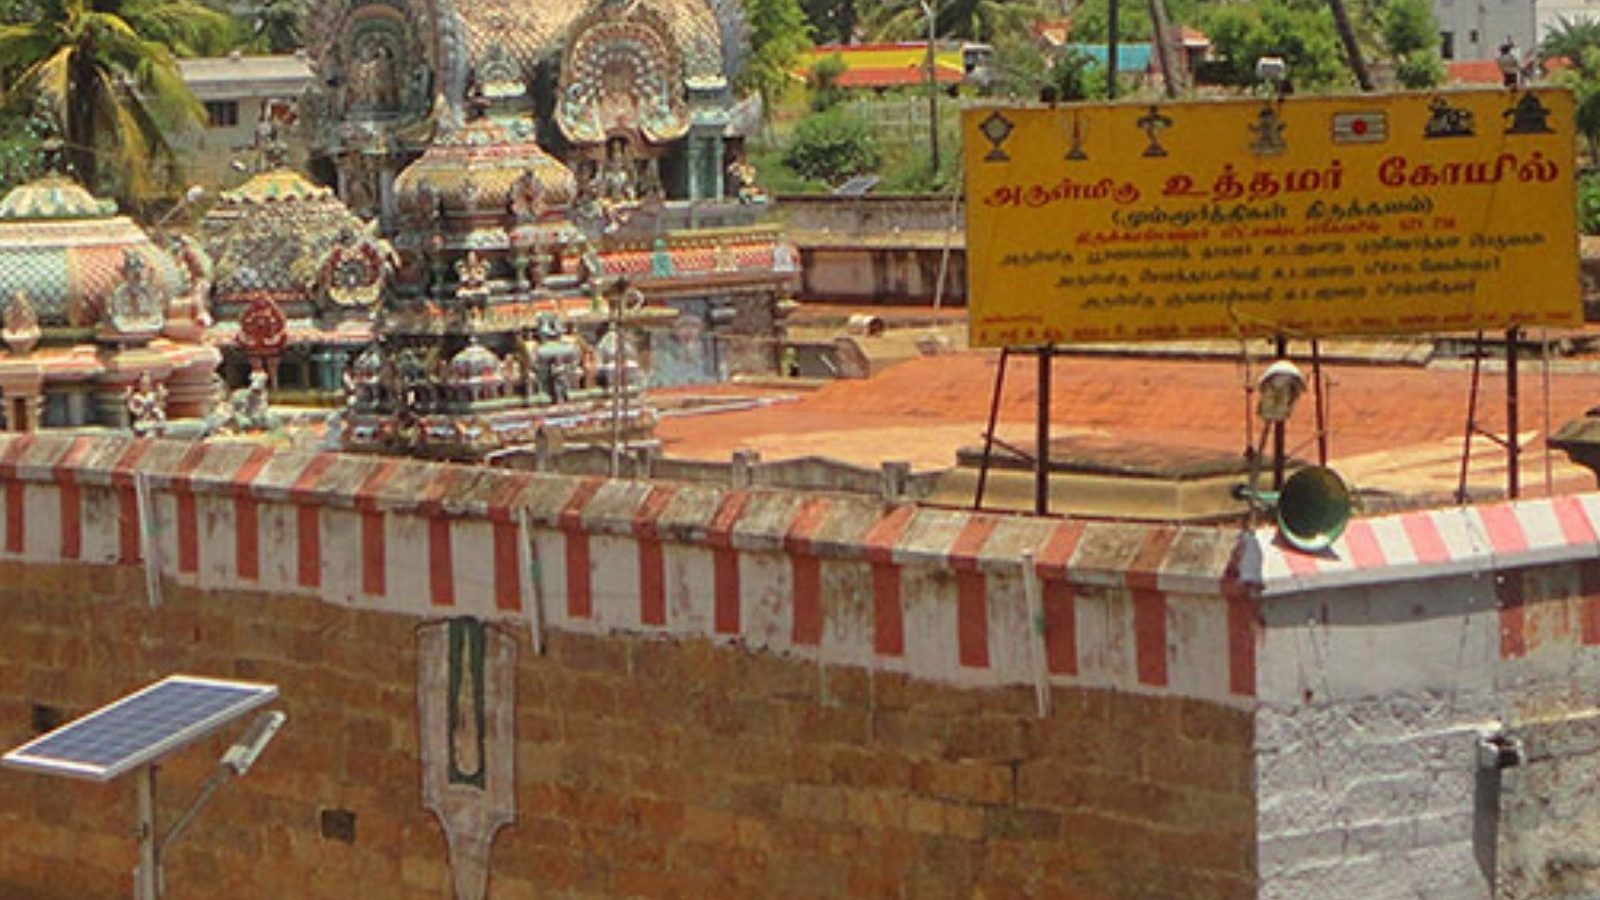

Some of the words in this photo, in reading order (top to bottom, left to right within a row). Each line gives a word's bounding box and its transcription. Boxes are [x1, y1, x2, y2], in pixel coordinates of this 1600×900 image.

[984, 179, 1141, 206] அருள்மிகு
[1161, 161, 1344, 202] உத்தமர்
[1378, 152, 1560, 187] கோயில்
